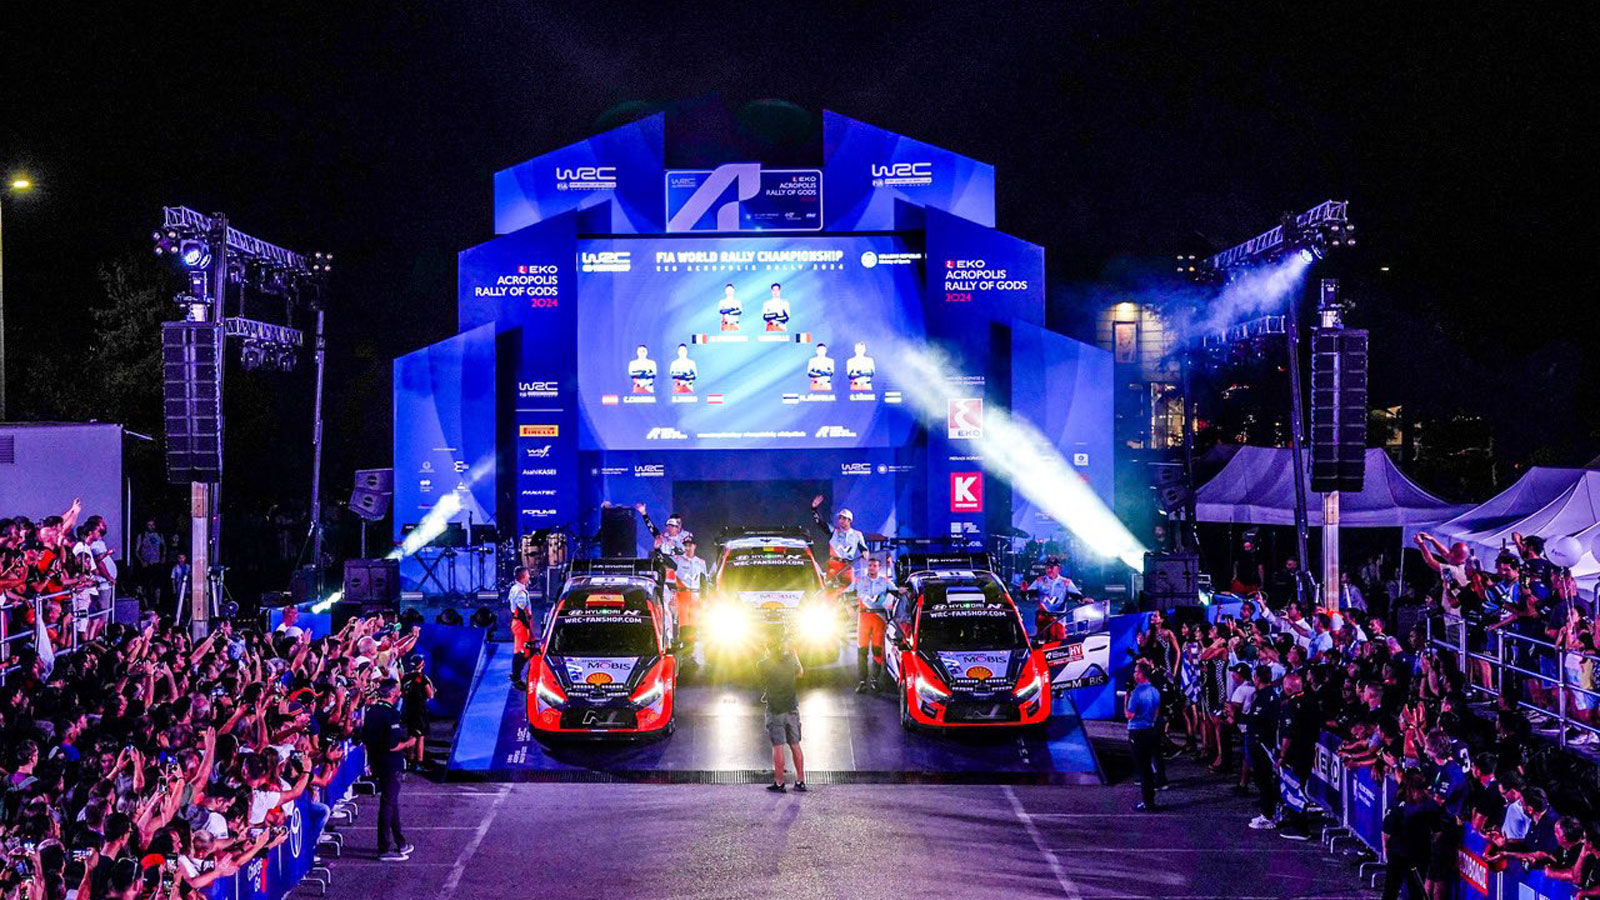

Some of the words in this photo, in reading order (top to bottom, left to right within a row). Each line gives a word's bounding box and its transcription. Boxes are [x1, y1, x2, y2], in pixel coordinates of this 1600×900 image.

[556, 167, 616, 180] WRC
[872, 163, 932, 177] WRC
[656, 252, 676, 263] FIA
[677, 252, 718, 263] WORLD
[720, 251, 755, 262] RALLY
[757, 250, 844, 262] CHAMPIONSHIP
[956, 259, 986, 268] EKO
[529, 265, 558, 274] EKO
[945, 269, 1007, 280] ACROPOLIS
[497, 275, 558, 285] ACROPOLIS
[945, 281, 977, 291] RALLY
[979, 281, 994, 290] OF
[996, 280, 1027, 290] GODS
[475, 287, 507, 297] RALLY
[509, 287, 525, 296] OF
[526, 286, 558, 296] GODS
[945, 293, 972, 302] 2024
[531, 298, 558, 308] 2024
[519, 382, 558, 391] WRC
[930, 610, 1007, 618] WRC-FANSHOP.COM
[564, 616, 642, 624] WRC-FANSHOP.COM
[963, 656, 1007, 664] MOBIS
[587, 662, 631, 671] MOBIS
[1072, 675, 1103, 689] MBIS
